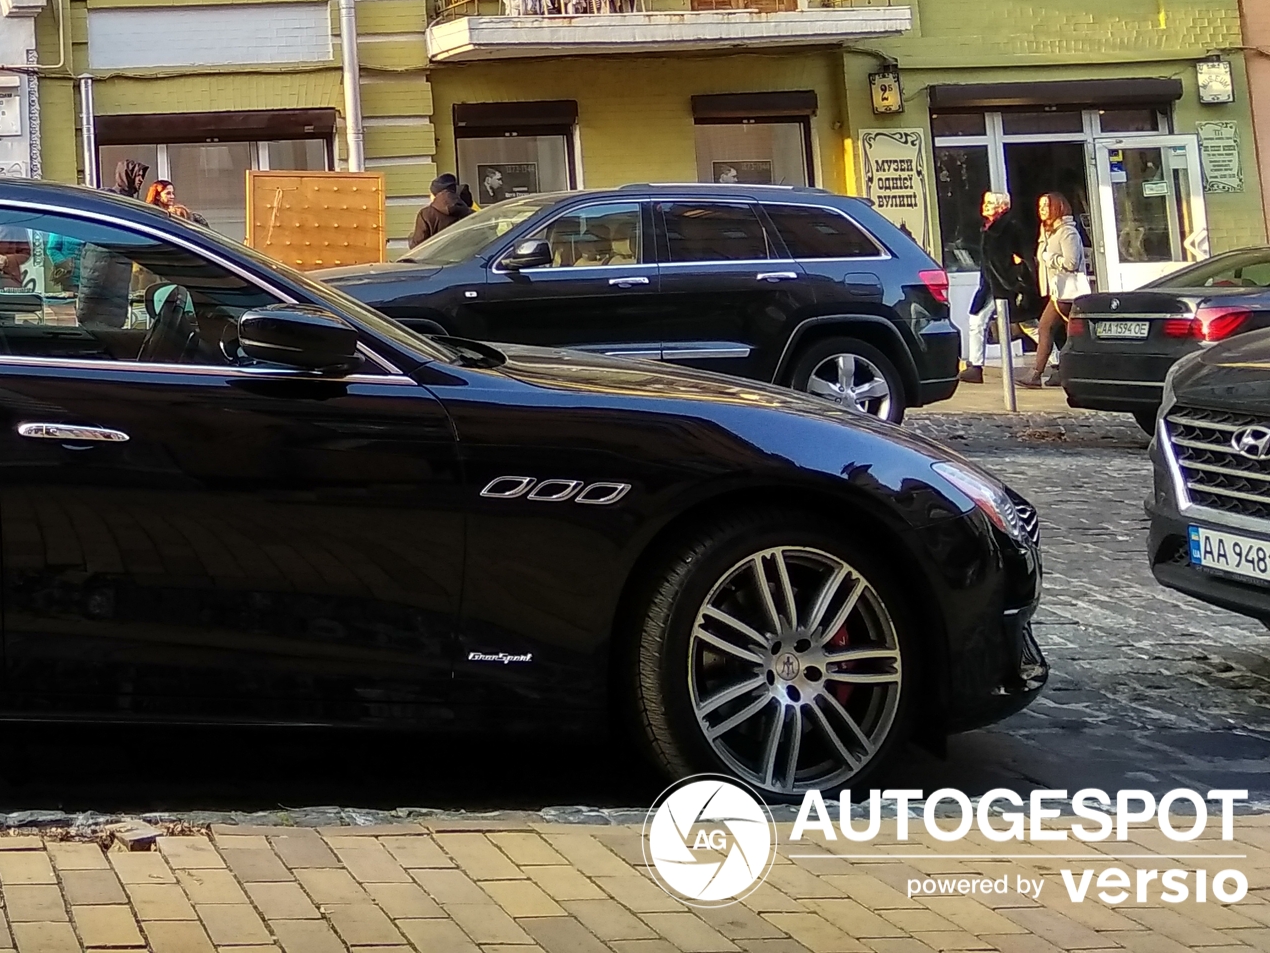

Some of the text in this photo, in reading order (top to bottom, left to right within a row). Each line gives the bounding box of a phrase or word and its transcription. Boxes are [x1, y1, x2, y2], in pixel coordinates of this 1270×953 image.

[1200, 74, 1230, 90] MUSEUM
[875, 158, 914, 173] МУЗЕЙ
[877, 174, 914, 192] ОДНІЄЇ
[877, 192, 917, 209] ВУЛИЦІ
[1101, 323, 1147, 335] AA 1594 OE
[1203, 535, 1270, 574] AA 948
